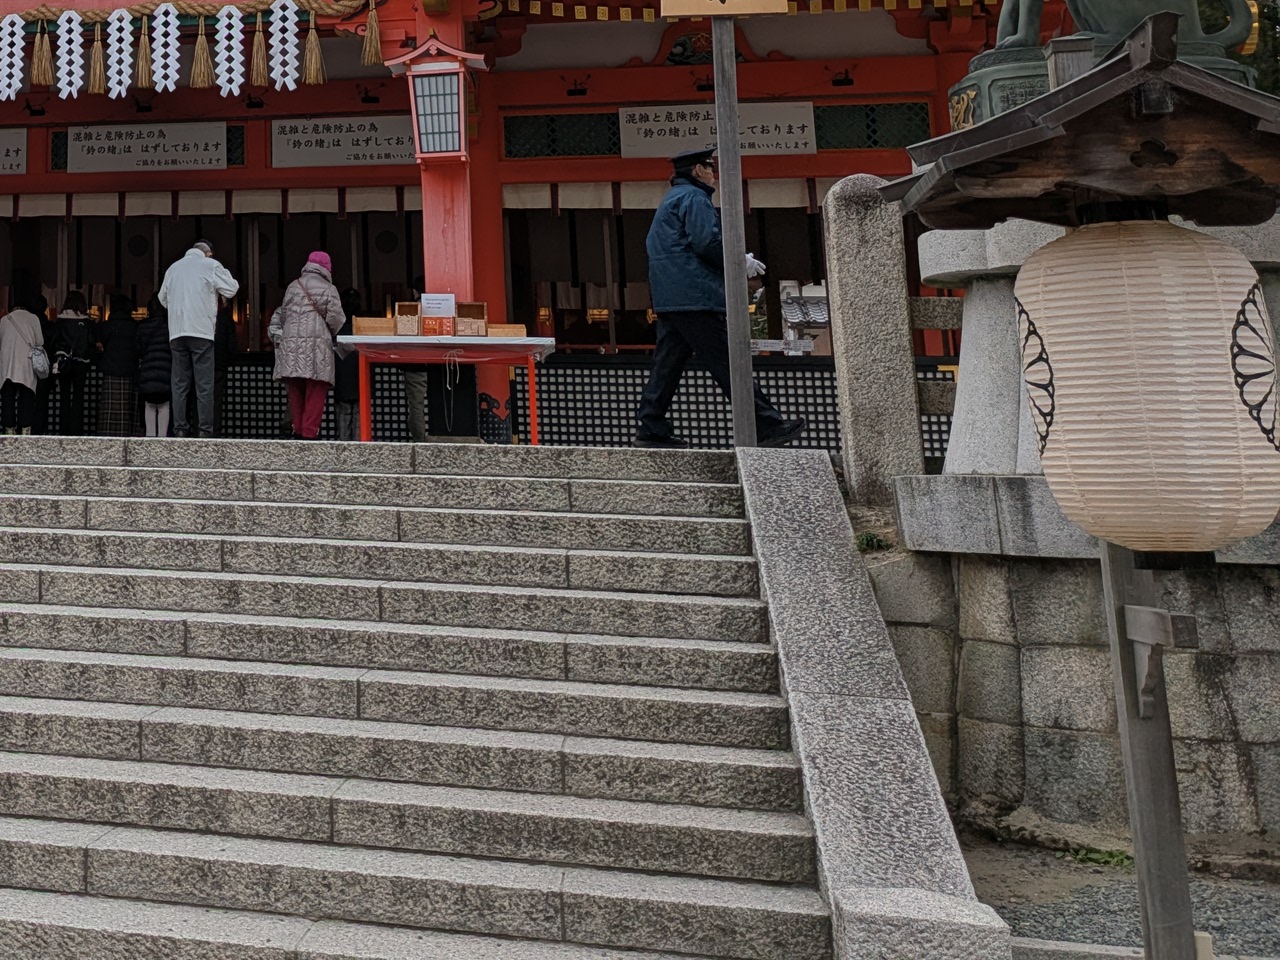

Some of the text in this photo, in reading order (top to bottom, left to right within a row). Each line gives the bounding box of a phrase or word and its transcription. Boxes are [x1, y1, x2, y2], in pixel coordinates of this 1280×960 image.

[625, 111, 740, 124] 混雑と危険防止
[73, 128, 167, 142] 混雑と危険防止の為
[277, 122, 379, 136] 混雑と危険防止の為
[140, 141, 222, 154] はずしております
[135, 157, 222, 167] ご協力をお願いいたします
